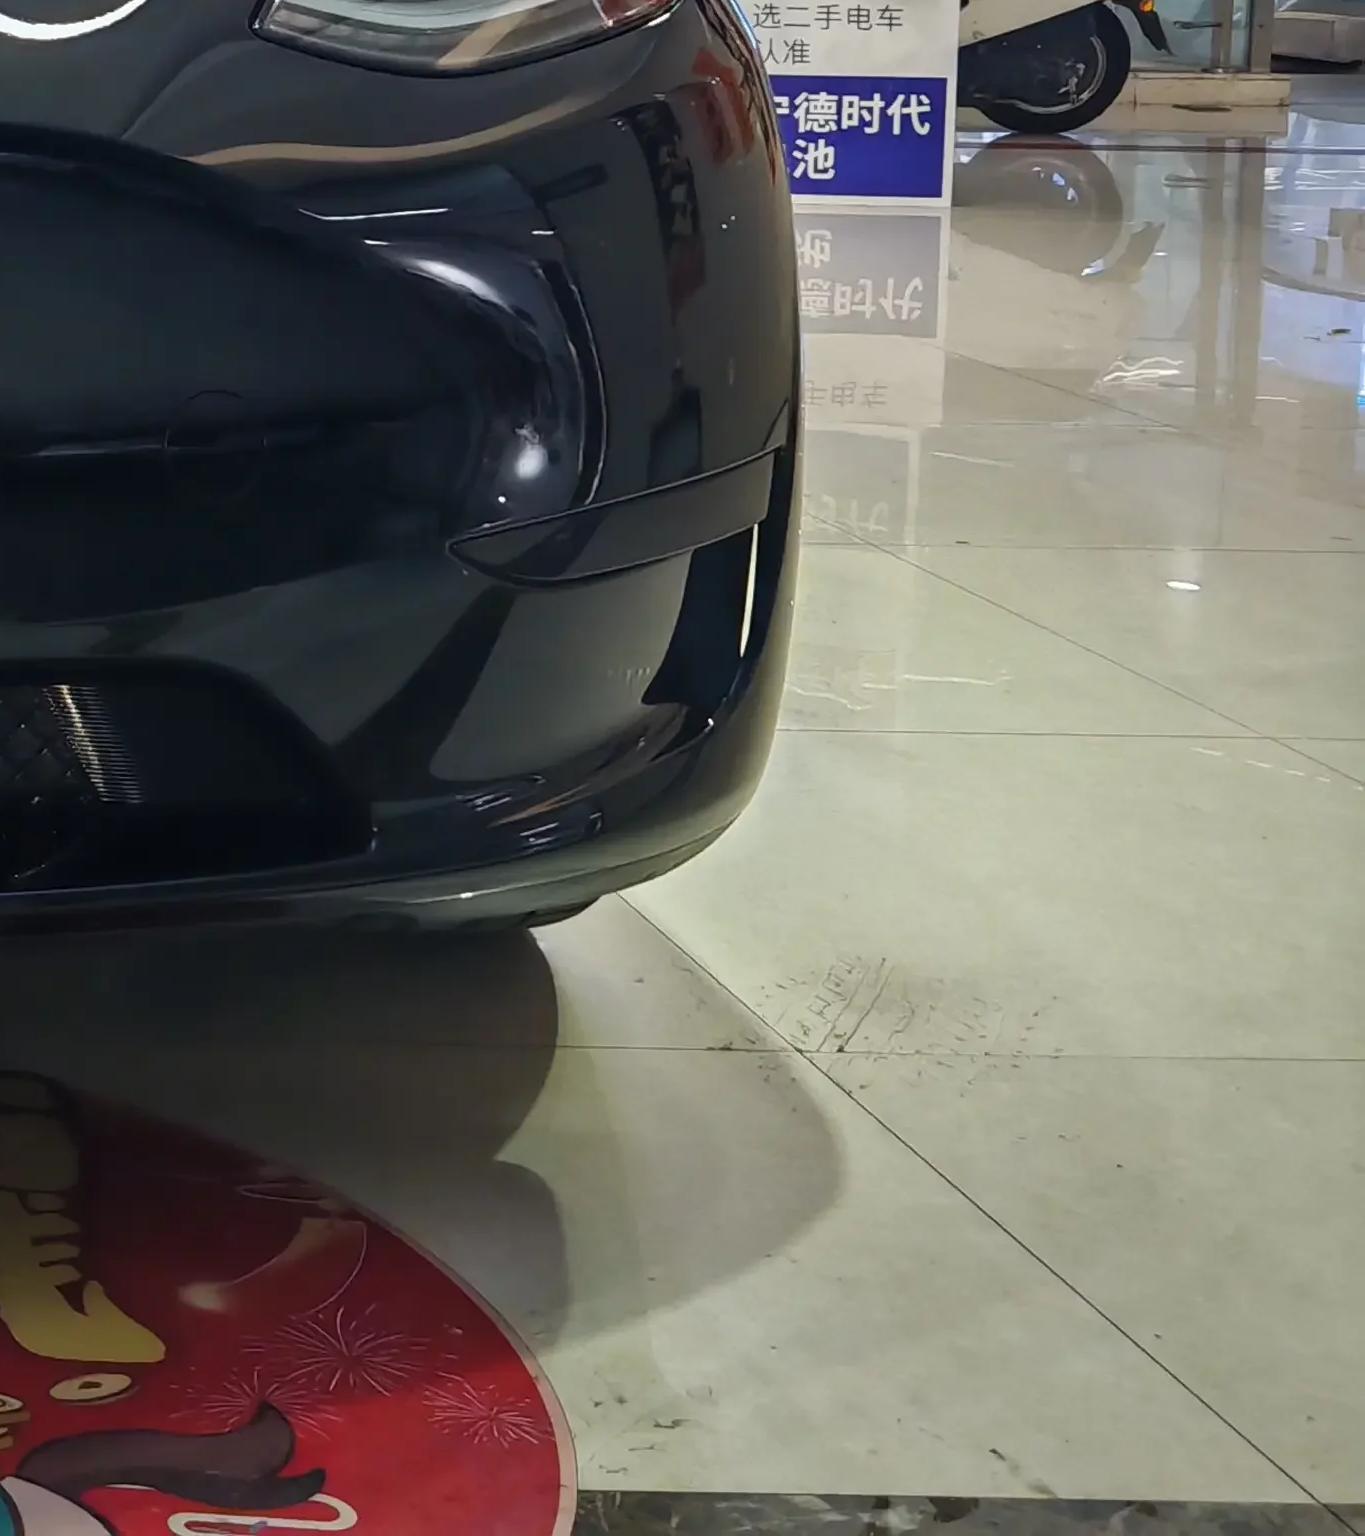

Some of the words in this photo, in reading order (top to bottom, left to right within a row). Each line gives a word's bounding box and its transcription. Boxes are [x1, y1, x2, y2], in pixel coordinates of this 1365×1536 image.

[753, 3, 904, 32] 选二手电车
[783, 138, 836, 180] 池
